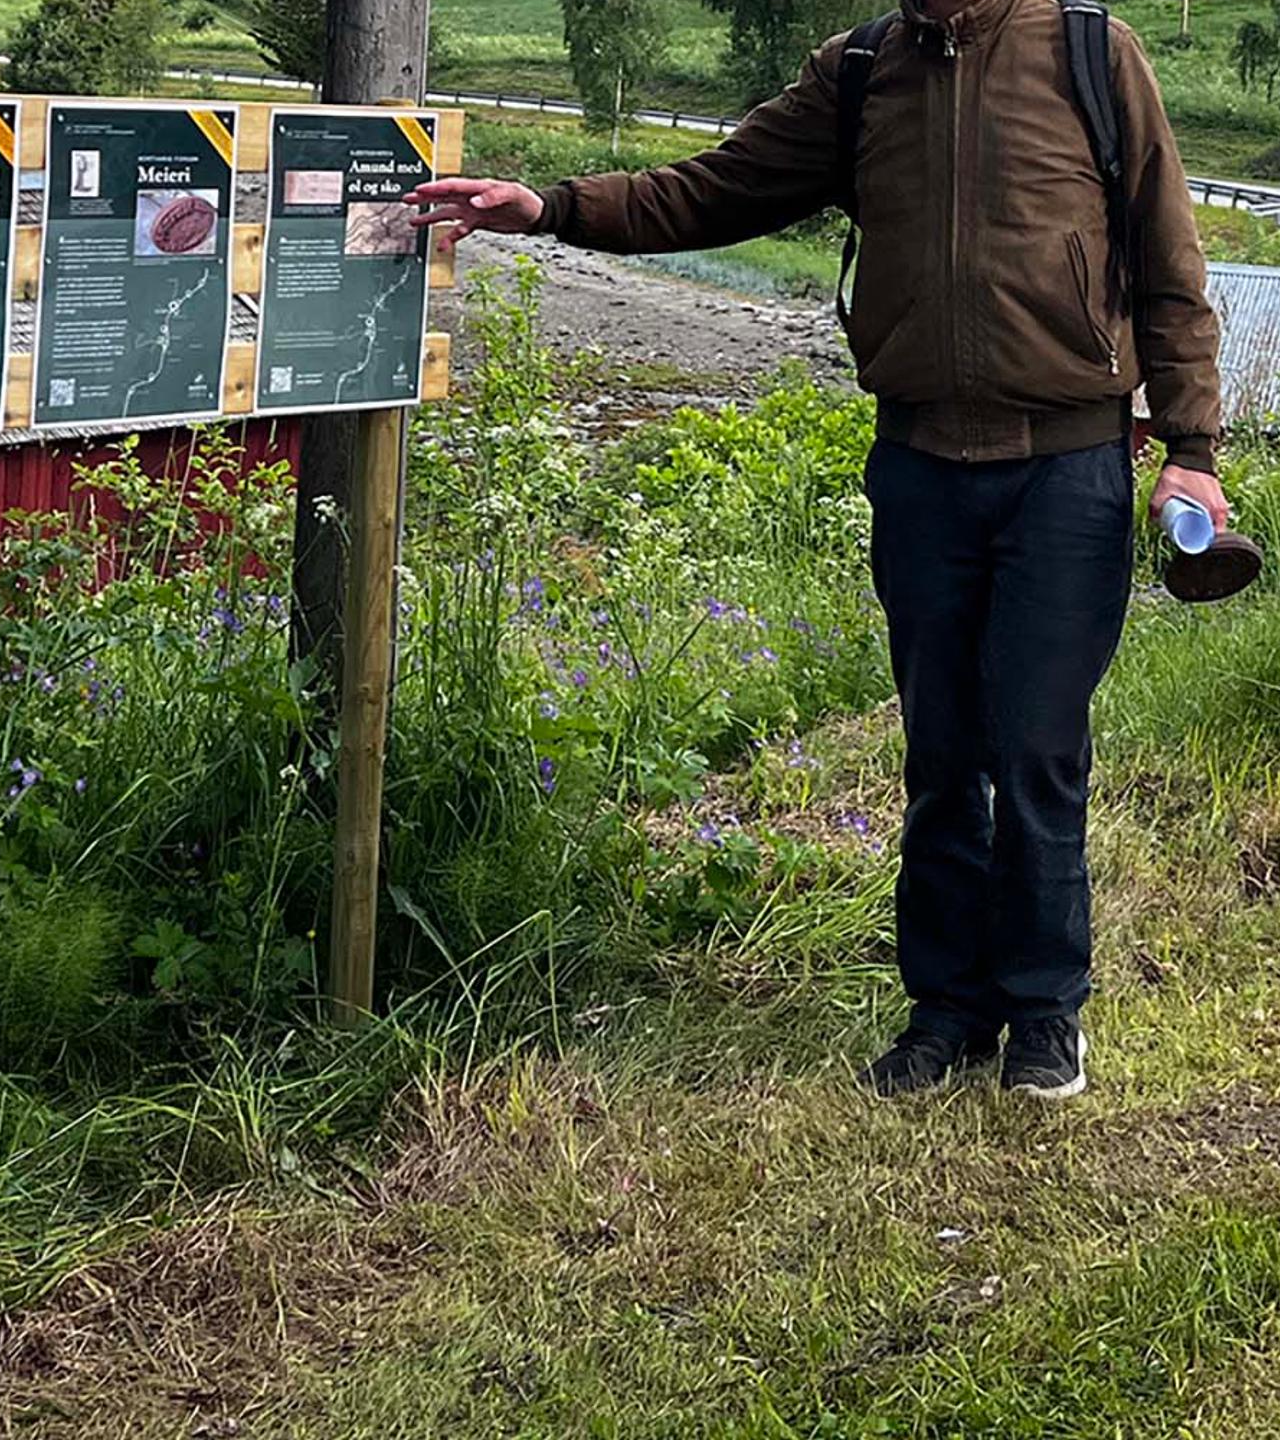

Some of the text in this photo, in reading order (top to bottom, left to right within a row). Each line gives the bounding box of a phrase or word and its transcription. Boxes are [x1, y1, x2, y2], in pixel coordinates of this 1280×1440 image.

[137, 165, 191, 183] Meieri
[348, 159, 423, 174] Amund med
[362, 182, 379, 196] og
[380, 178, 402, 193] sko
